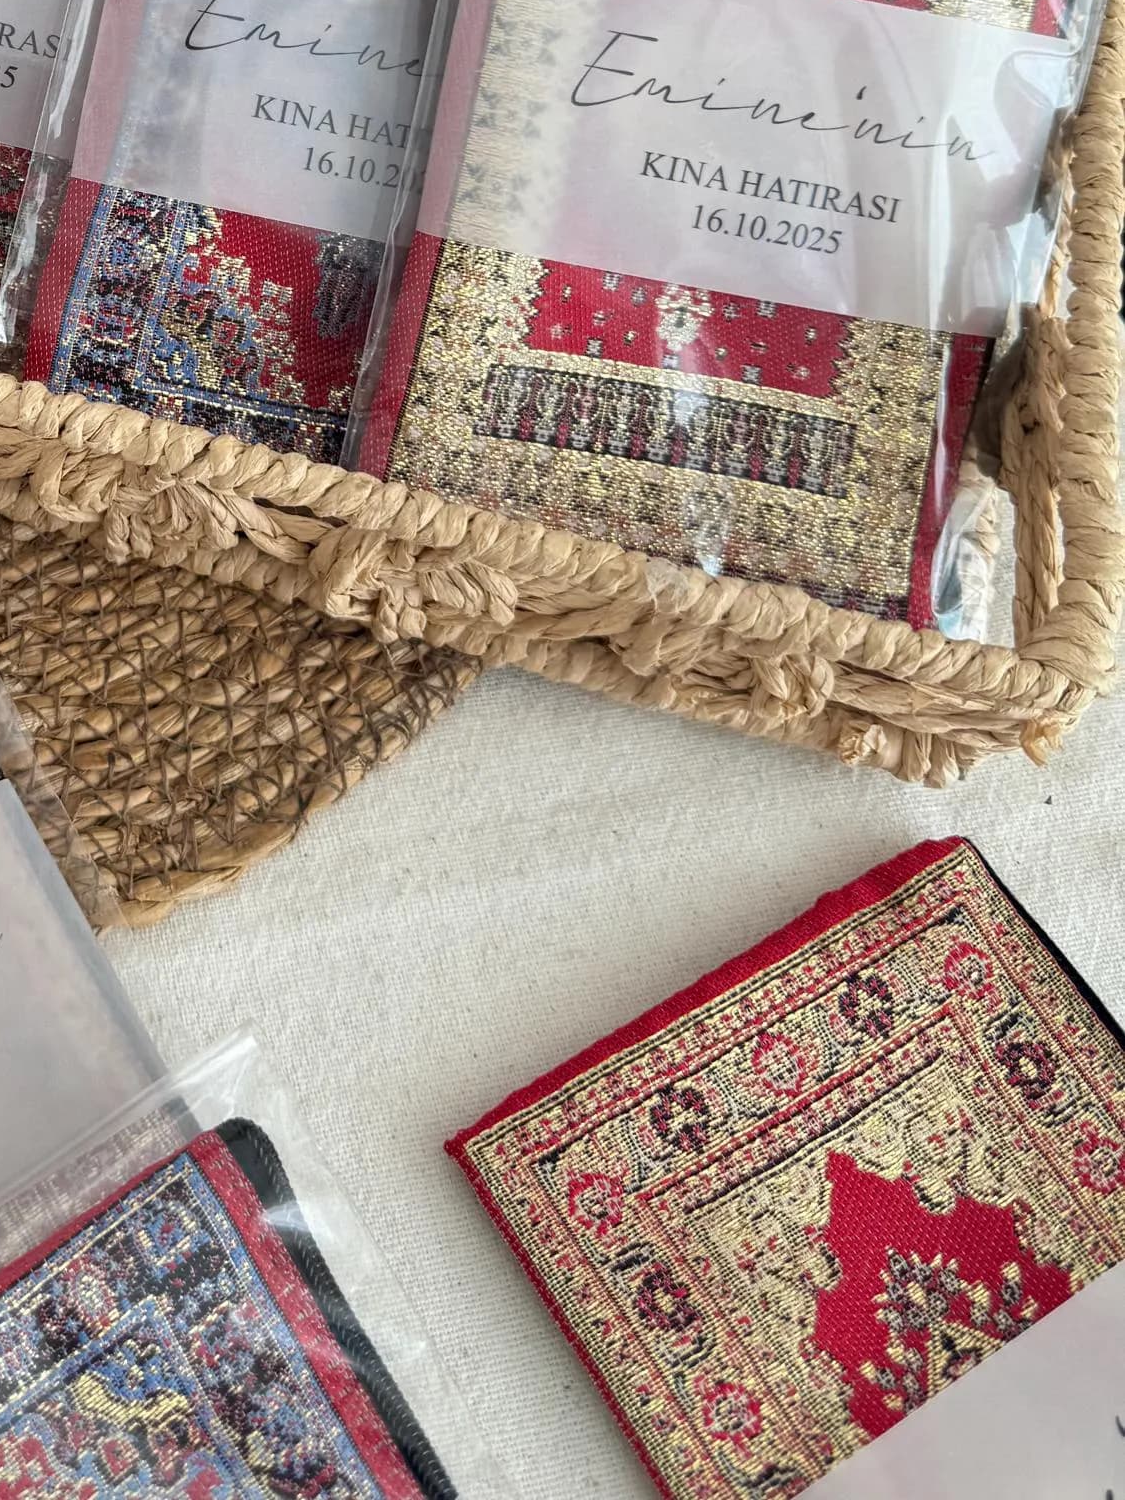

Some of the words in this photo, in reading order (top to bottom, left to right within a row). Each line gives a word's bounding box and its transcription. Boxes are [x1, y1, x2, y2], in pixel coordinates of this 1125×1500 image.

[251, 93, 338, 134] KINA
[347, 113, 424, 150] HAT
[639, 150, 728, 192] KINA
[740, 169, 902, 223] HATIRASI
[691, 204, 843, 254] 16.10.2025
